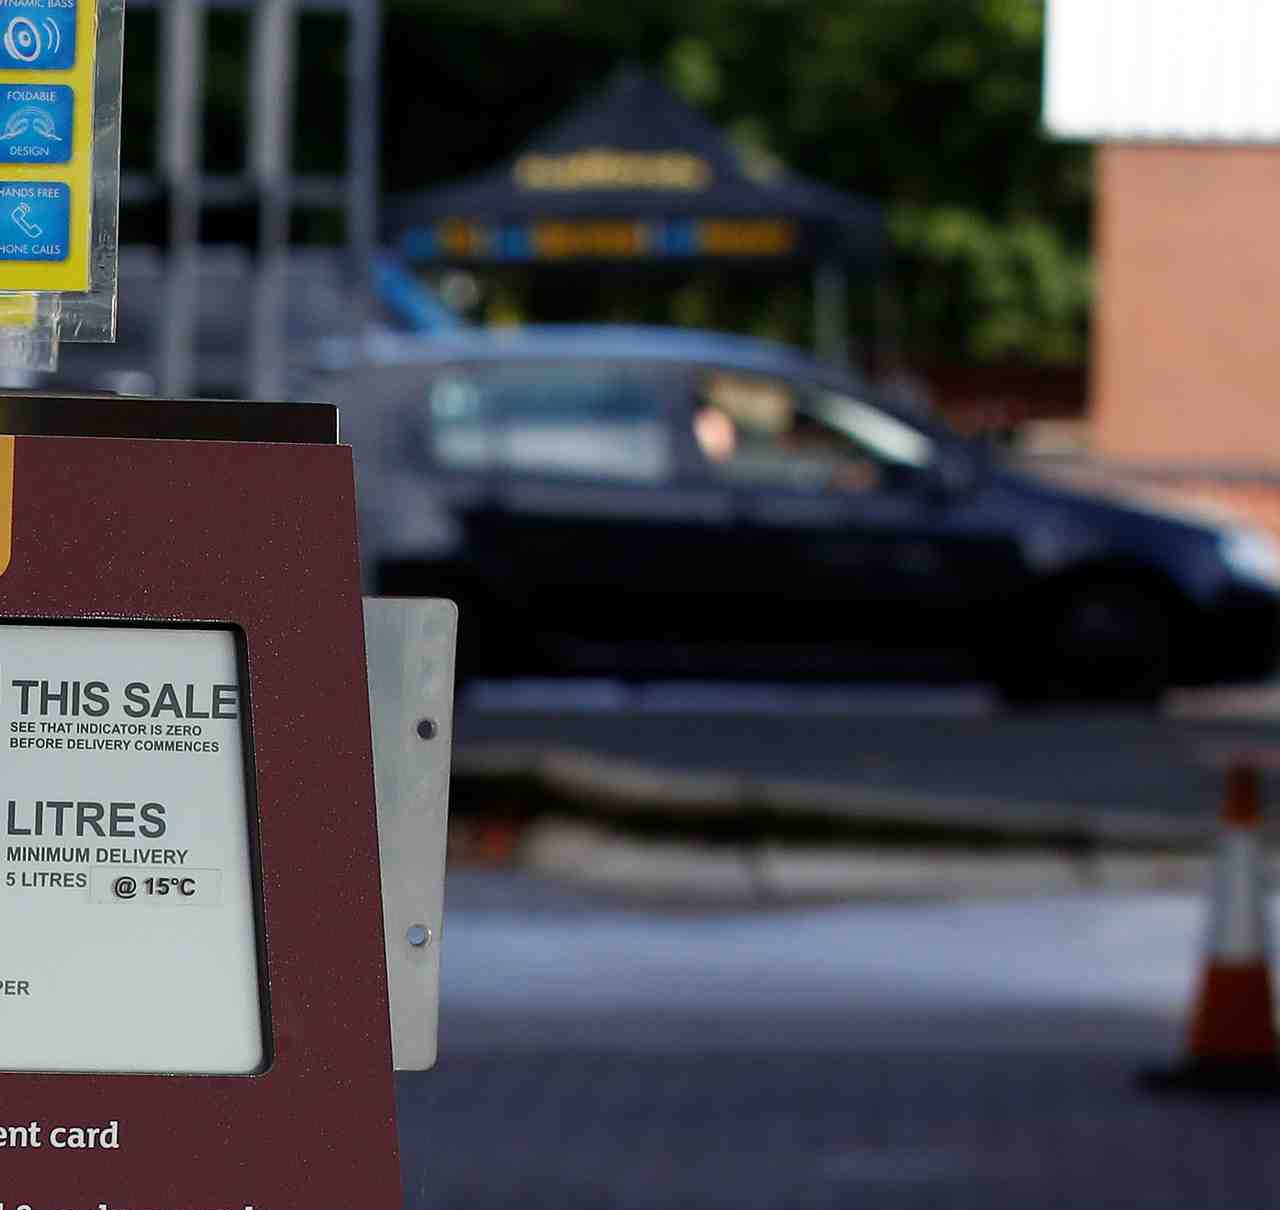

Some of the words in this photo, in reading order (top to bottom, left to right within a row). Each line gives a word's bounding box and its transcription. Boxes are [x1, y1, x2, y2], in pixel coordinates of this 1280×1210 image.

[7, 91, 56, 101] FOLDABLE
[10, 147, 49, 157] DESIGN
[38, 188, 60, 198] FREE
[32, 244, 61, 255] CALLS
[12, 680, 110, 718] THIS
[123, 682, 239, 720] SALE
[10, 722, 36, 733] SEE
[40, 722, 73, 734] THAT
[76, 723, 147, 736] INDICATOR
[150, 724, 162, 736] IS
[166, 725, 202, 737] ZERO
[10, 738, 63, 749] BEFORE
[67, 739, 131, 751] DELIVERY
[134, 741, 219, 753] COMMENCES
[7, 800, 167, 838] LITRES
[7, 847, 89, 863] MINIMUM
[96, 848, 189, 865] DELIVERY
[6, 872, 16, 887] 5
[21, 872, 87, 888] LITRES
[114, 876, 137, 899] @
[49, 1121, 120, 1149] card
